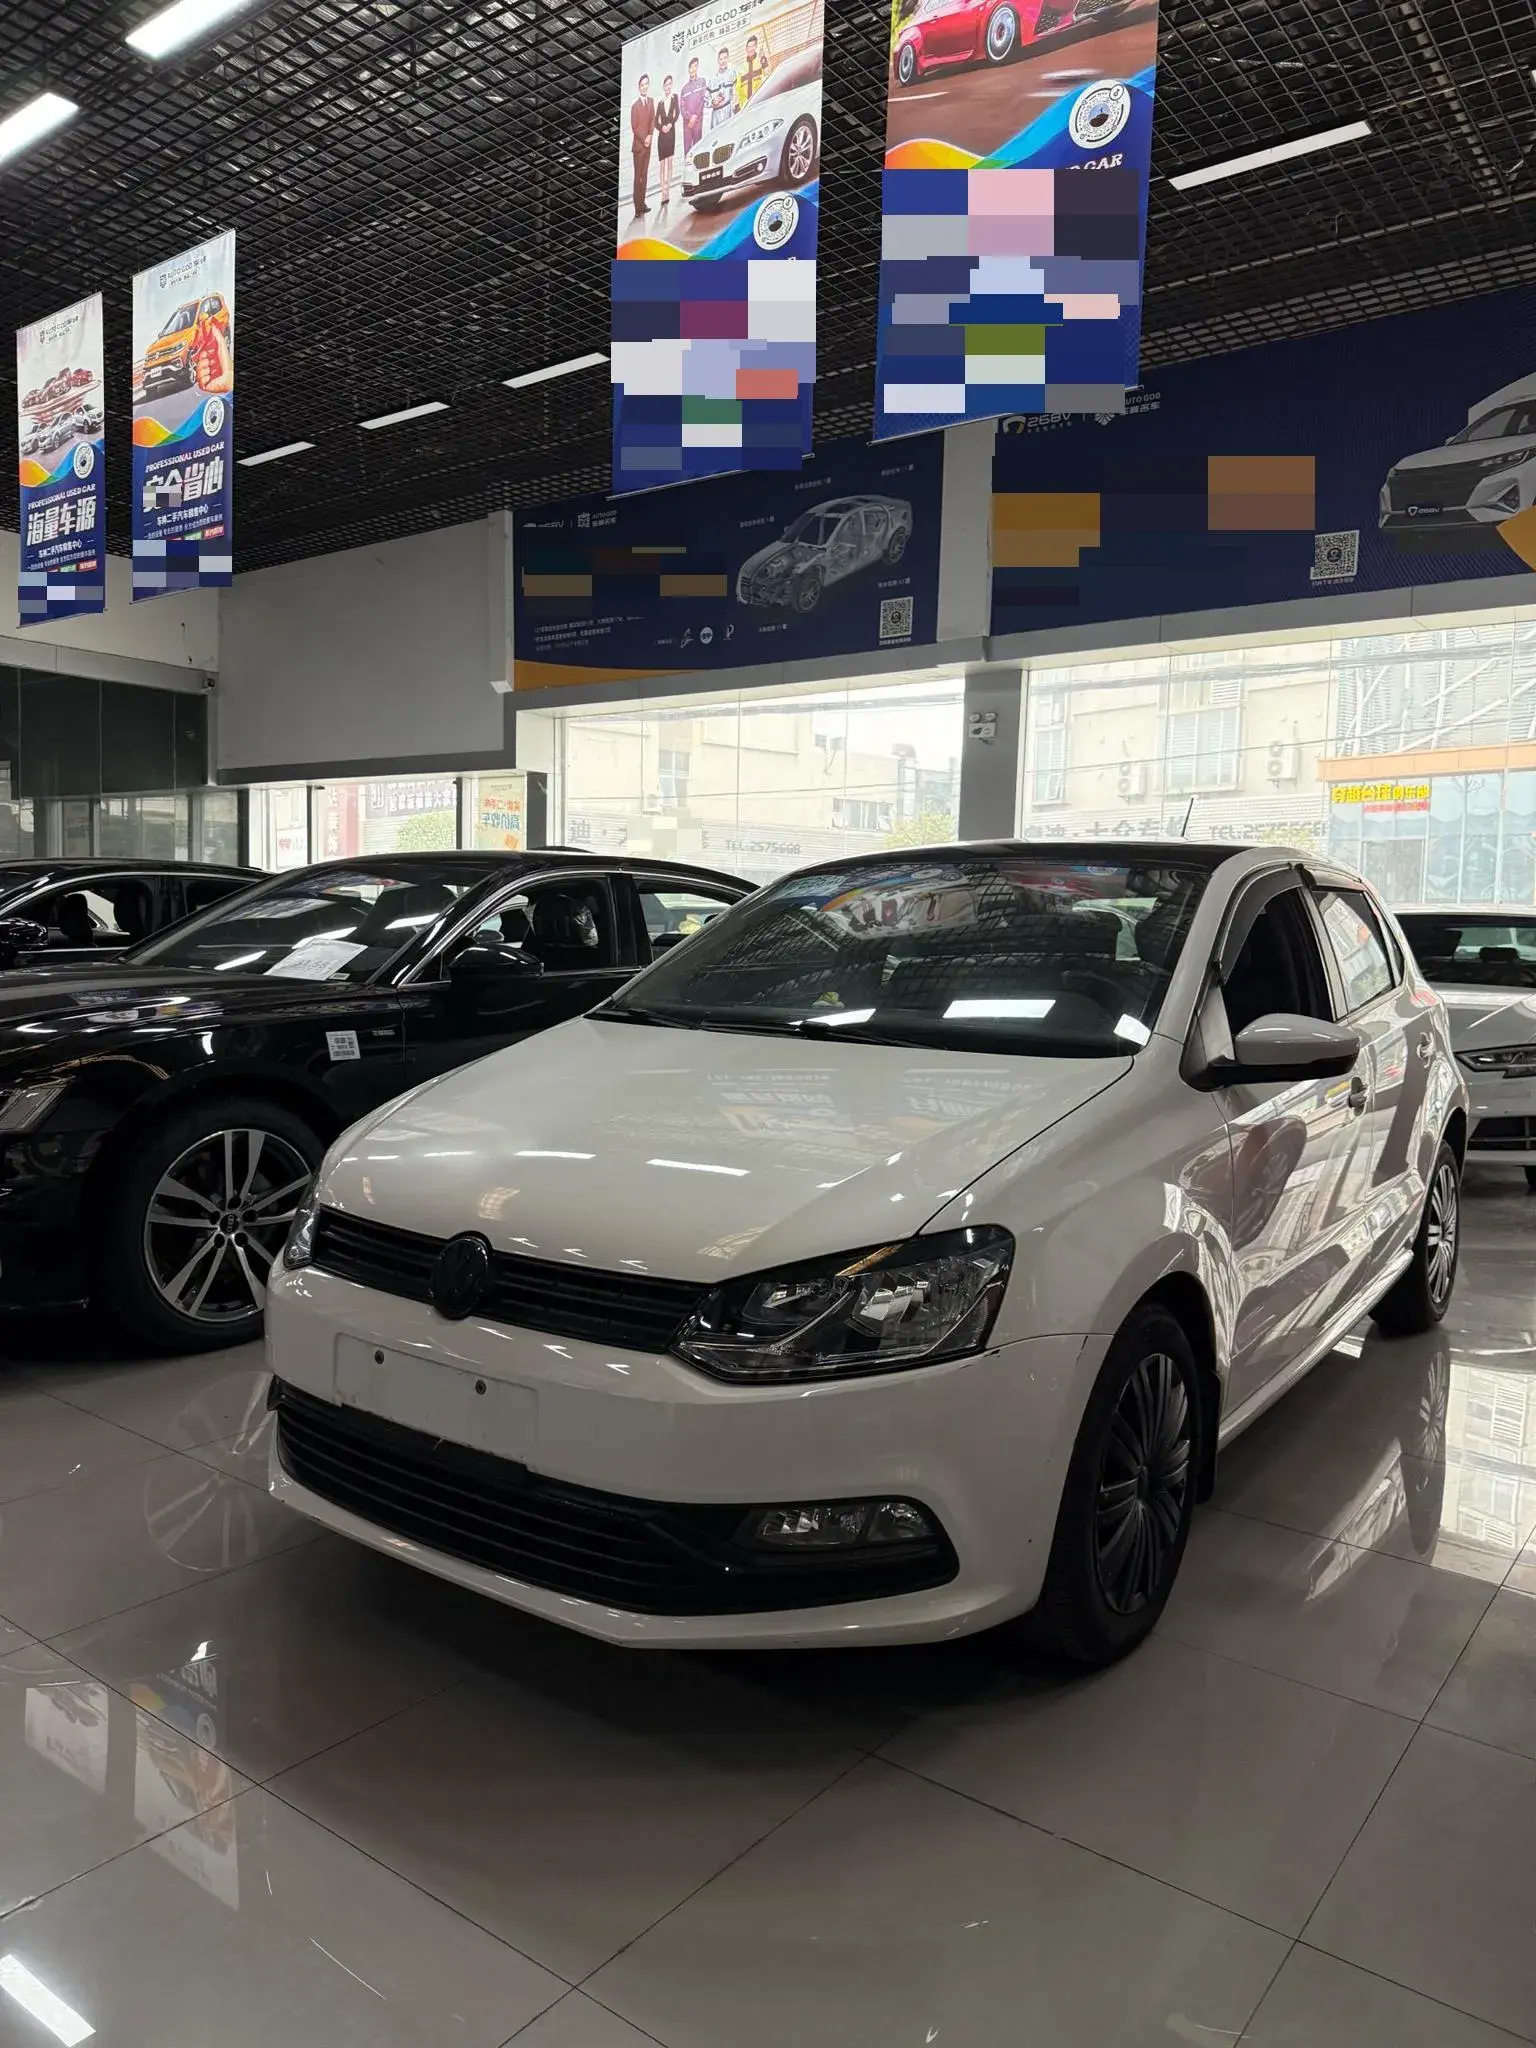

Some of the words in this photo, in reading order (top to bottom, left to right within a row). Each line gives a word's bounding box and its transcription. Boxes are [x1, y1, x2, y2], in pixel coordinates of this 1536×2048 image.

[686, 19, 713, 38] AUTO
[714, 9, 738, 25] GOD
[1083, 154, 1124, 169] CAR
[145, 453, 193, 473] PROFESSIONAL
[193, 446, 210, 459] USED
[210, 441, 225, 452] CAR
[27, 493, 66, 510] PROFESSIONAL
[66, 487, 82, 498] USED
[81, 483, 96, 493] CAR
[27, 496, 97, 546] 海量车源
